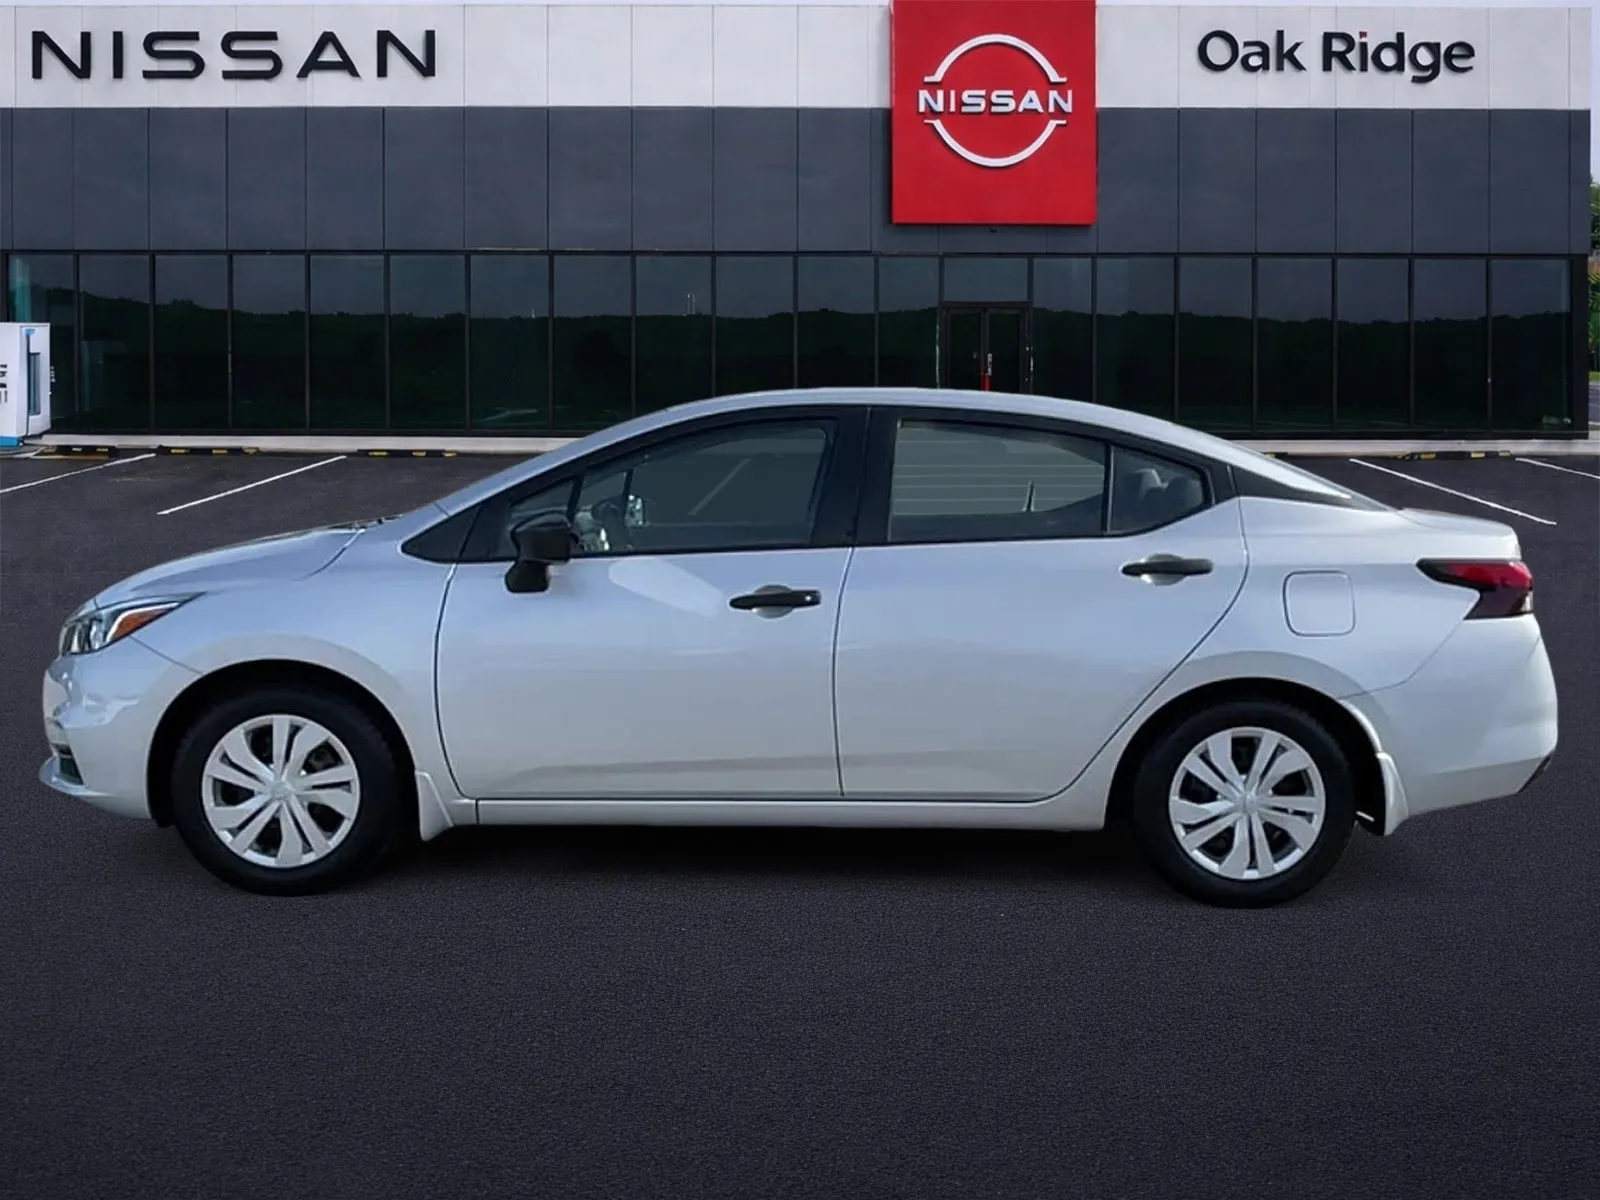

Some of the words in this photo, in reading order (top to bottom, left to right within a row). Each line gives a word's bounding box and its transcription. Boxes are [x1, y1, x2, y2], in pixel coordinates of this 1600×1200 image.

[31, 29, 436, 79] NISSAN
[1198, 30, 1306, 73] Oak
[1321, 31, 1475, 83] Ridge
[918, 89, 1073, 113] NISSAN
